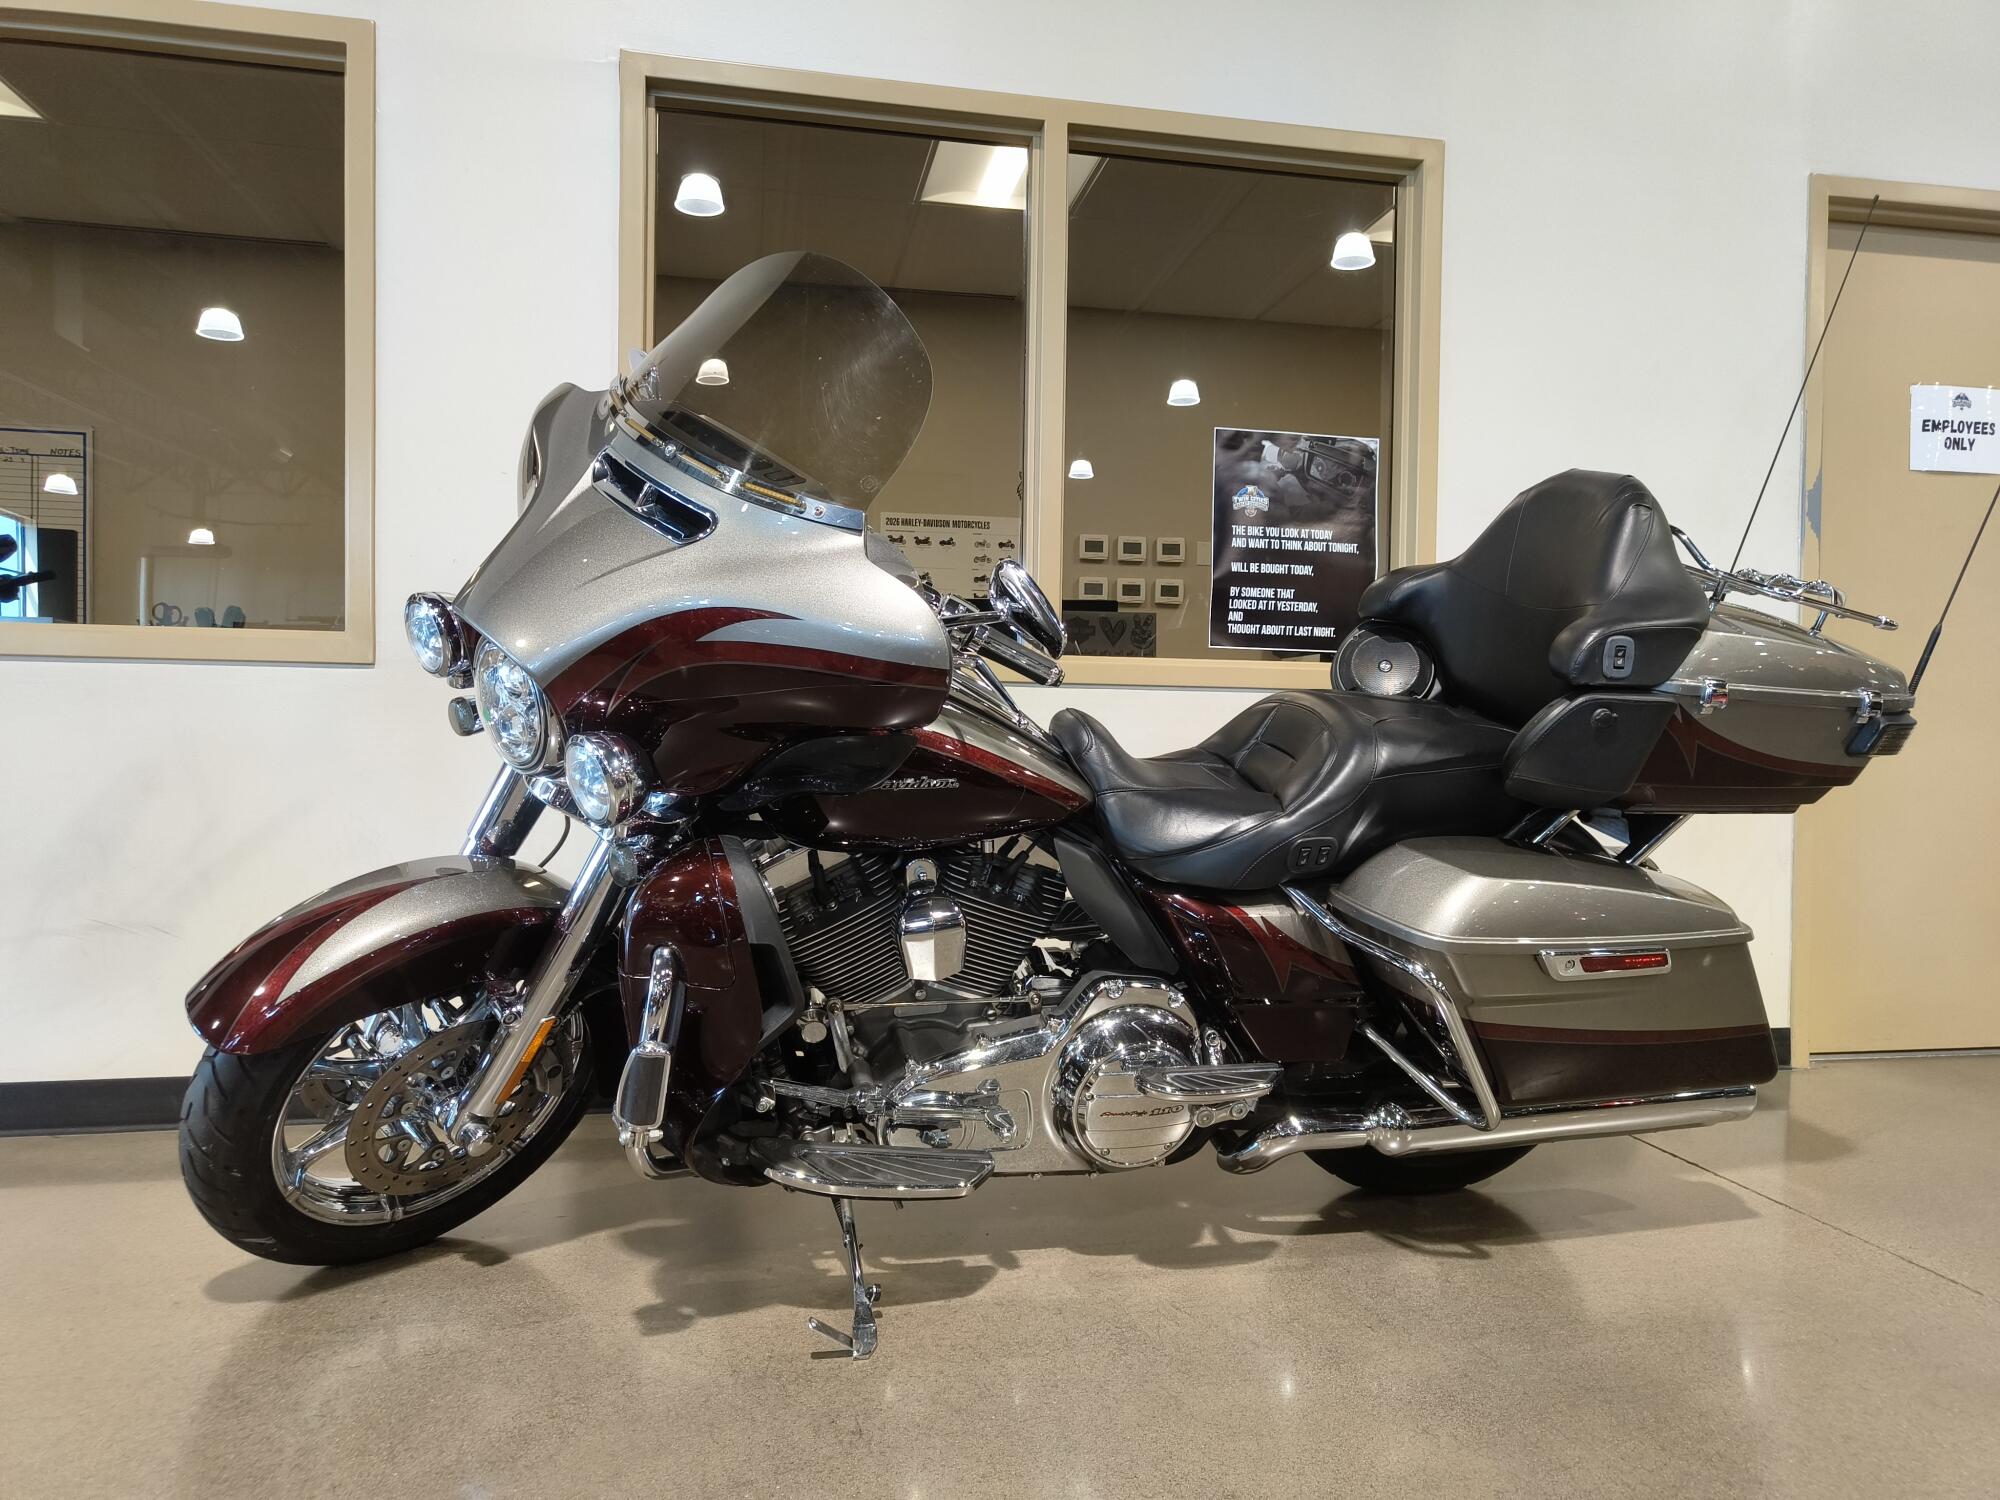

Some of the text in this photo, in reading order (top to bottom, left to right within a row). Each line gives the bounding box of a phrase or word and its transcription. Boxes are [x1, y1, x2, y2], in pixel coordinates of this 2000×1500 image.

[1921, 418, 1996, 436] EMPLOYEES
[1944, 436, 1976, 451] ONLY
[50, 447, 81, 456] NOTES
[952, 519, 991, 530] MOTORCYCLES
[1231, 525, 1333, 540] THE BIKE YOU LOOK AT TODAY
[1231, 537, 1359, 555] AND WANT TO THINK ABOUT TONIGHT,
[1231, 562, 1314, 577] WILL BE BOUGHT TODAY,
[1230, 586, 1295, 599] BY SOMEONE THAT
[1229, 599, 1319, 614] LOOKED AT IT YESTERDAY,
[1227, 611, 1244, 622] AND
[1227, 623, 1336, 638] THOUGHT ABOUT IT LAST NIGHT.
